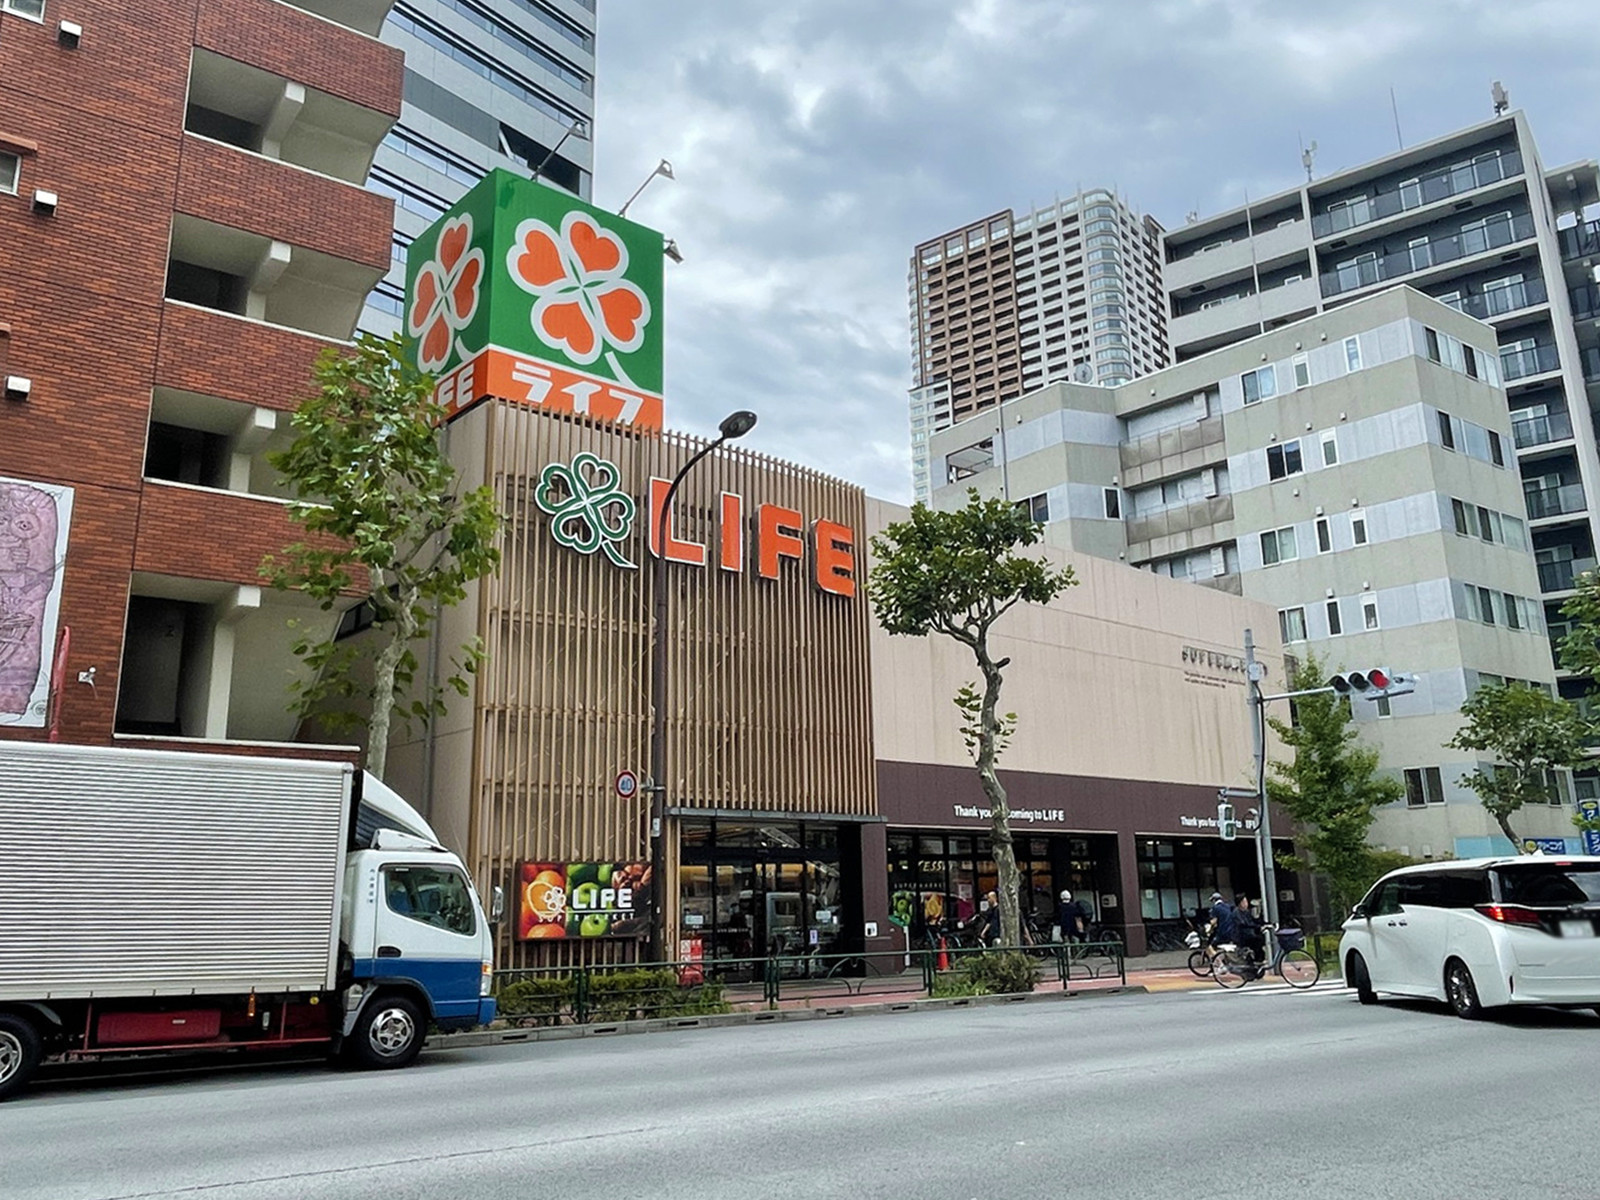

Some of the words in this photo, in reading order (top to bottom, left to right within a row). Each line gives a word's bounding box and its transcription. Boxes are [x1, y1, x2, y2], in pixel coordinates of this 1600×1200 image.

[430, 364, 474, 414] FE
[512, 361, 644, 425] ライフ
[649, 476, 855, 598] LIFE
[620, 778, 633, 791] 40
[954, 805, 978, 817] Thank
[1034, 810, 1042, 819] to
[1042, 810, 1065, 821] LIFE
[573, 888, 632, 909] LIFE
